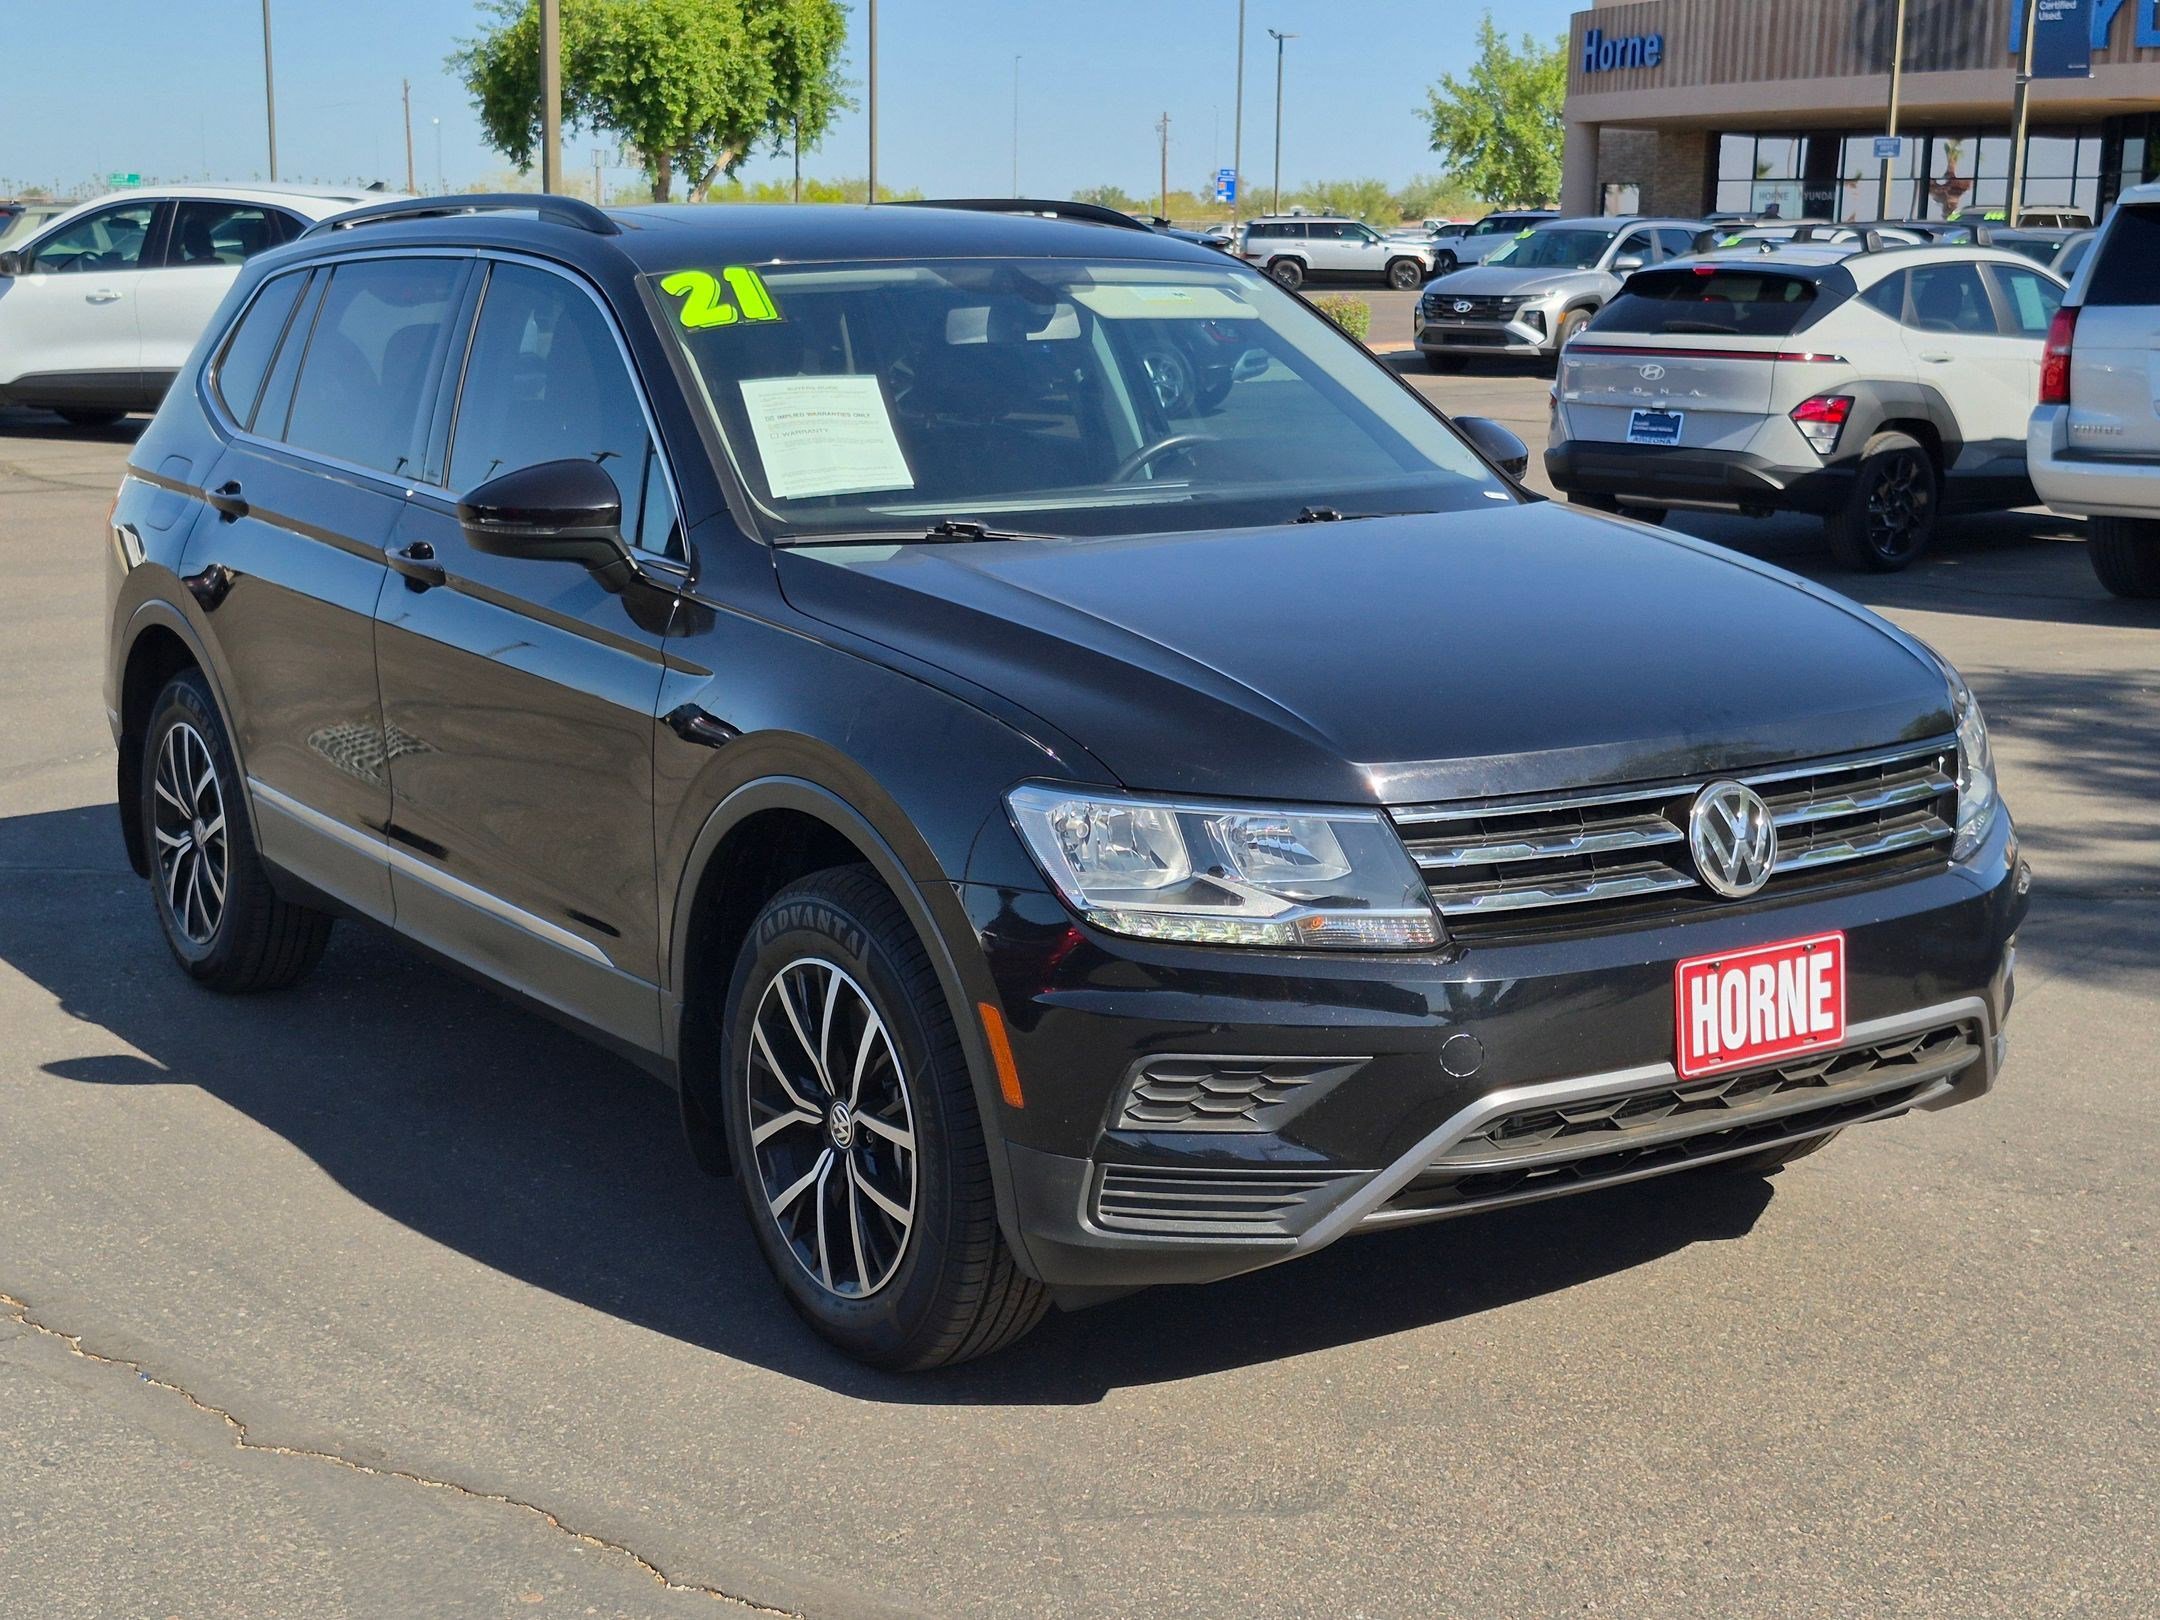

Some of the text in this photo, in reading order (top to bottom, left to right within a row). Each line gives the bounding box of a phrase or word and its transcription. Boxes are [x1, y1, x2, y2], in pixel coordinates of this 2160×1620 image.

[1584, 28, 1663, 74] Horne
[1758, 191, 1790, 201] HORNE
[660, 266, 779, 328] 21
[1608, 386, 1700, 397] KONA
[777, 412, 805, 420] IMPLIED
[782, 428, 828, 438] WARRANTY
[762, 904, 860, 958] ADVANTA
[1691, 951, 1834, 1057] HORNE
